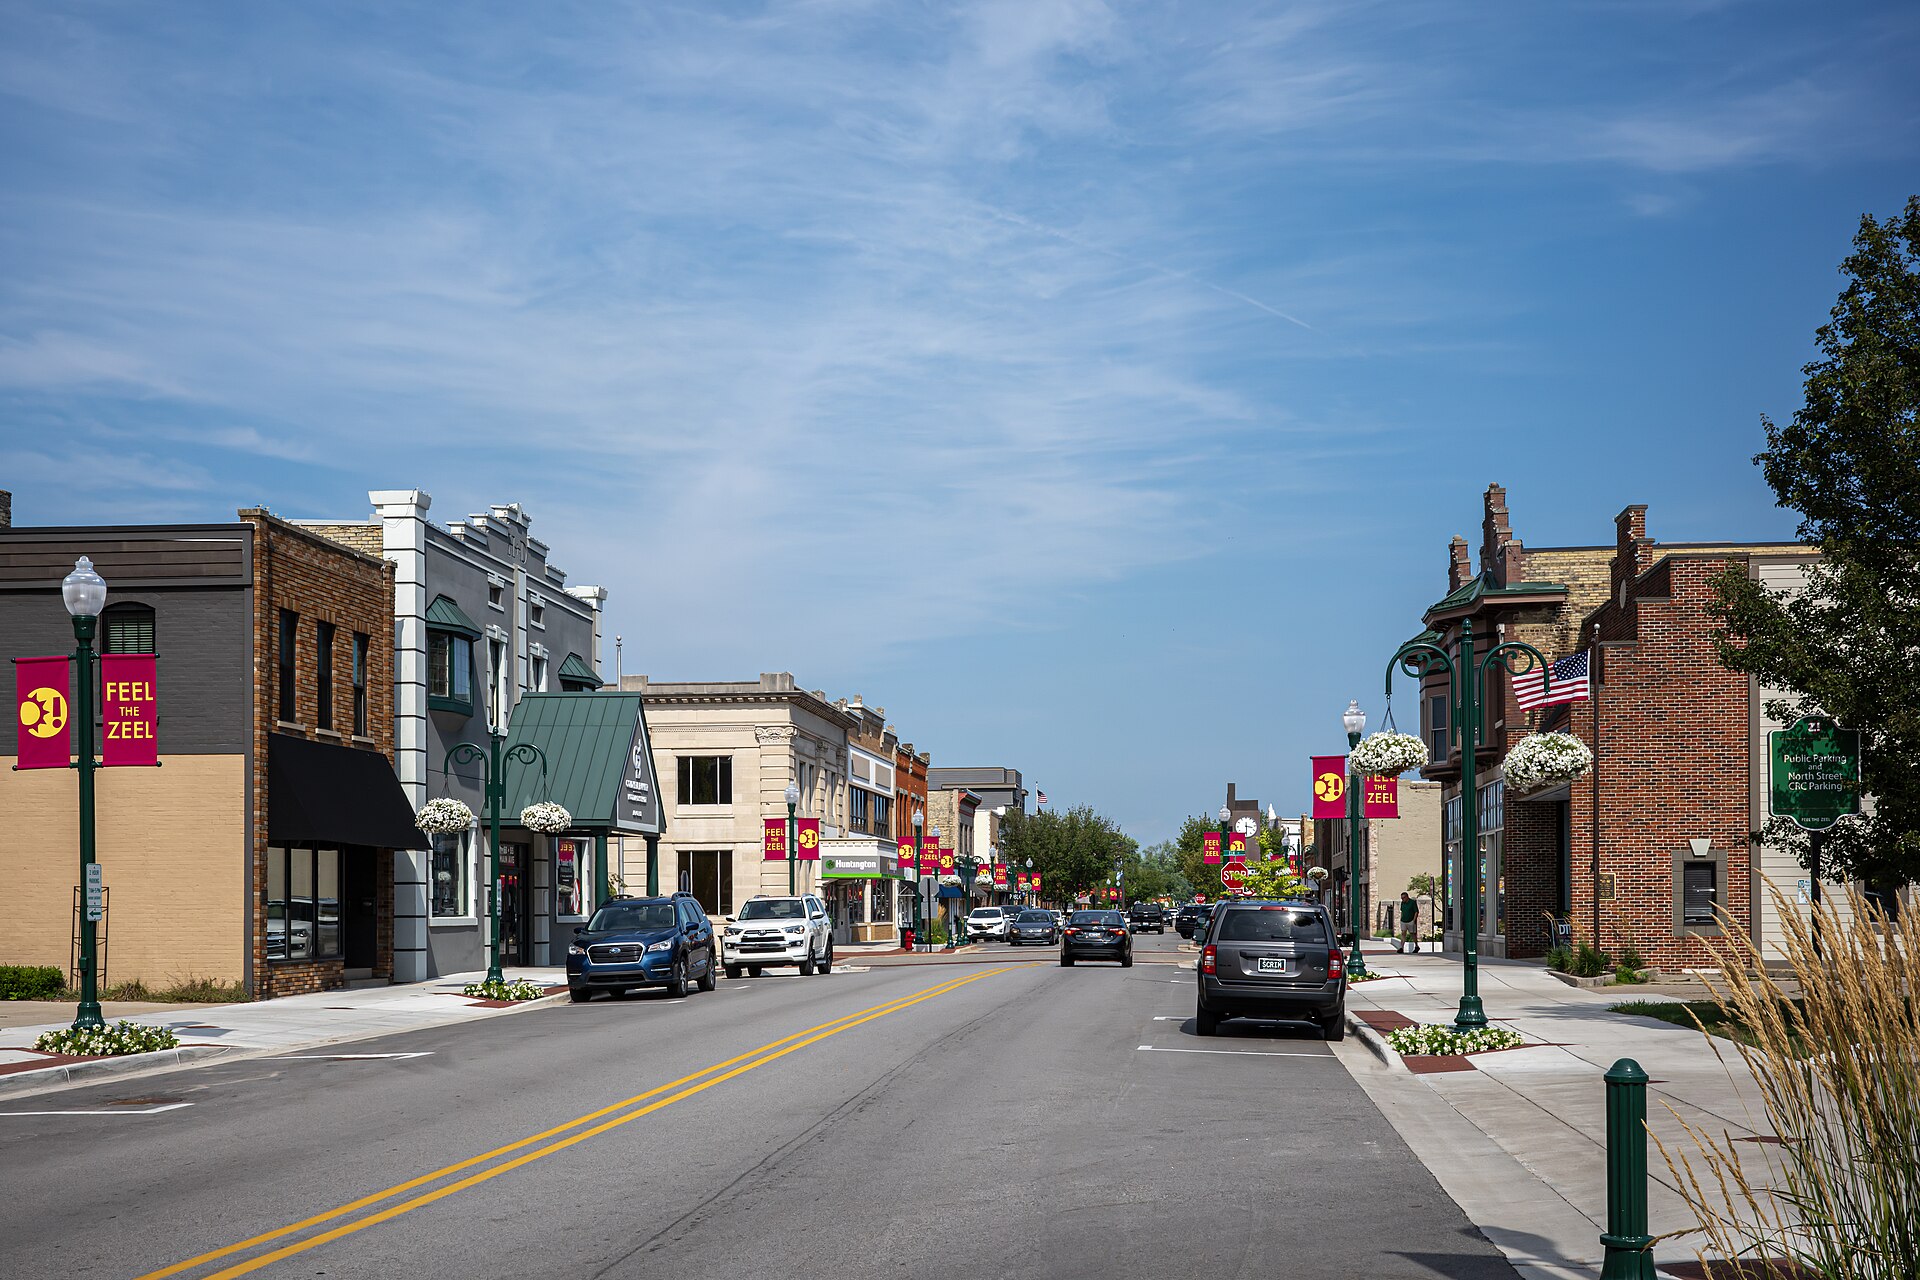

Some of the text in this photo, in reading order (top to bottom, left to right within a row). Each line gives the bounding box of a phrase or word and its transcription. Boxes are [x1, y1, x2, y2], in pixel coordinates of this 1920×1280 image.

[106, 681, 154, 702] FEEL
[118, 706, 140, 717] THE
[107, 720, 154, 739] ZEEL
[1783, 754, 1847, 764] Public Parking
[1788, 772, 1842, 780] North Street
[1788, 782, 1843, 791] CRC Parking
[1367, 792, 1396, 804] ZEEL
[766, 828, 785, 837] FEEL
[766, 842, 785, 851] ZEEL
[835, 859, 877, 871] Huntington
